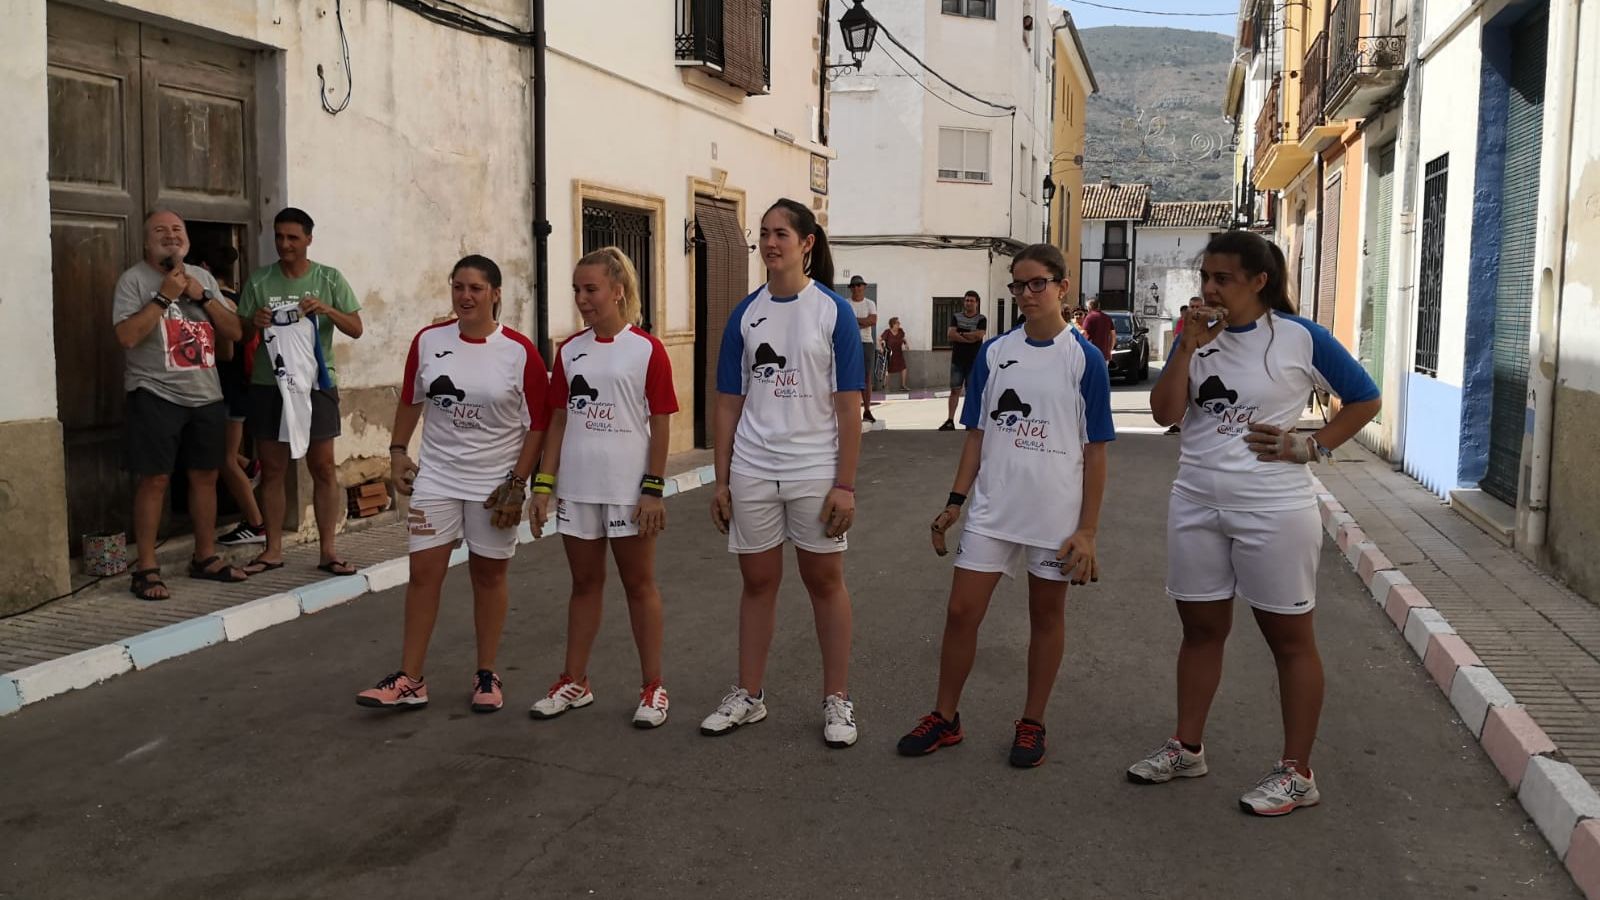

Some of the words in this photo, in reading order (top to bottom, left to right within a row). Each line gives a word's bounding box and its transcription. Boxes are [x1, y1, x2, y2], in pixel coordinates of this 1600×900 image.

[775, 372, 799, 387] Nel
[453, 405, 482, 420] Nel
[587, 405, 614, 420] Nel
[1222, 409, 1257, 425] Nel
[1017, 421, 1048, 439] Nel
